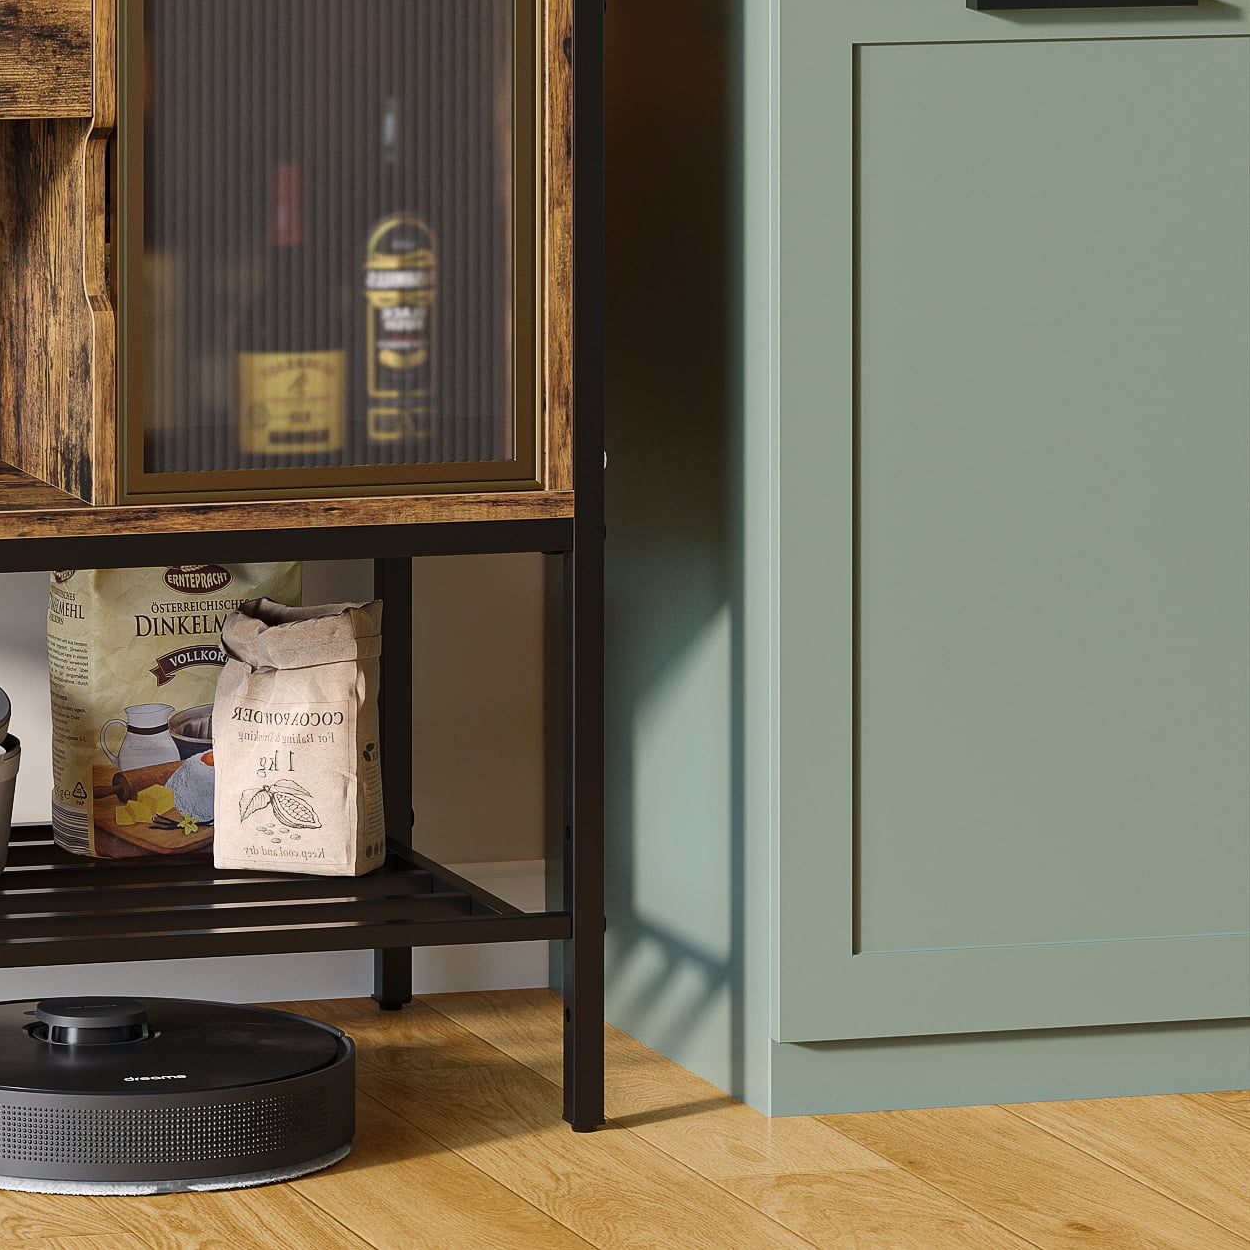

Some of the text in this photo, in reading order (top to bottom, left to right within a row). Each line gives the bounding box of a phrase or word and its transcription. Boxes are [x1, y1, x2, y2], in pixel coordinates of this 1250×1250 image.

[167, 572, 228, 589] ERNTEPRACHT
[151, 598, 250, 614] ÖSTERREICHISCHE
[134, 613, 228, 637] DINKELM
[123, 1074, 187, 1082] dreame
